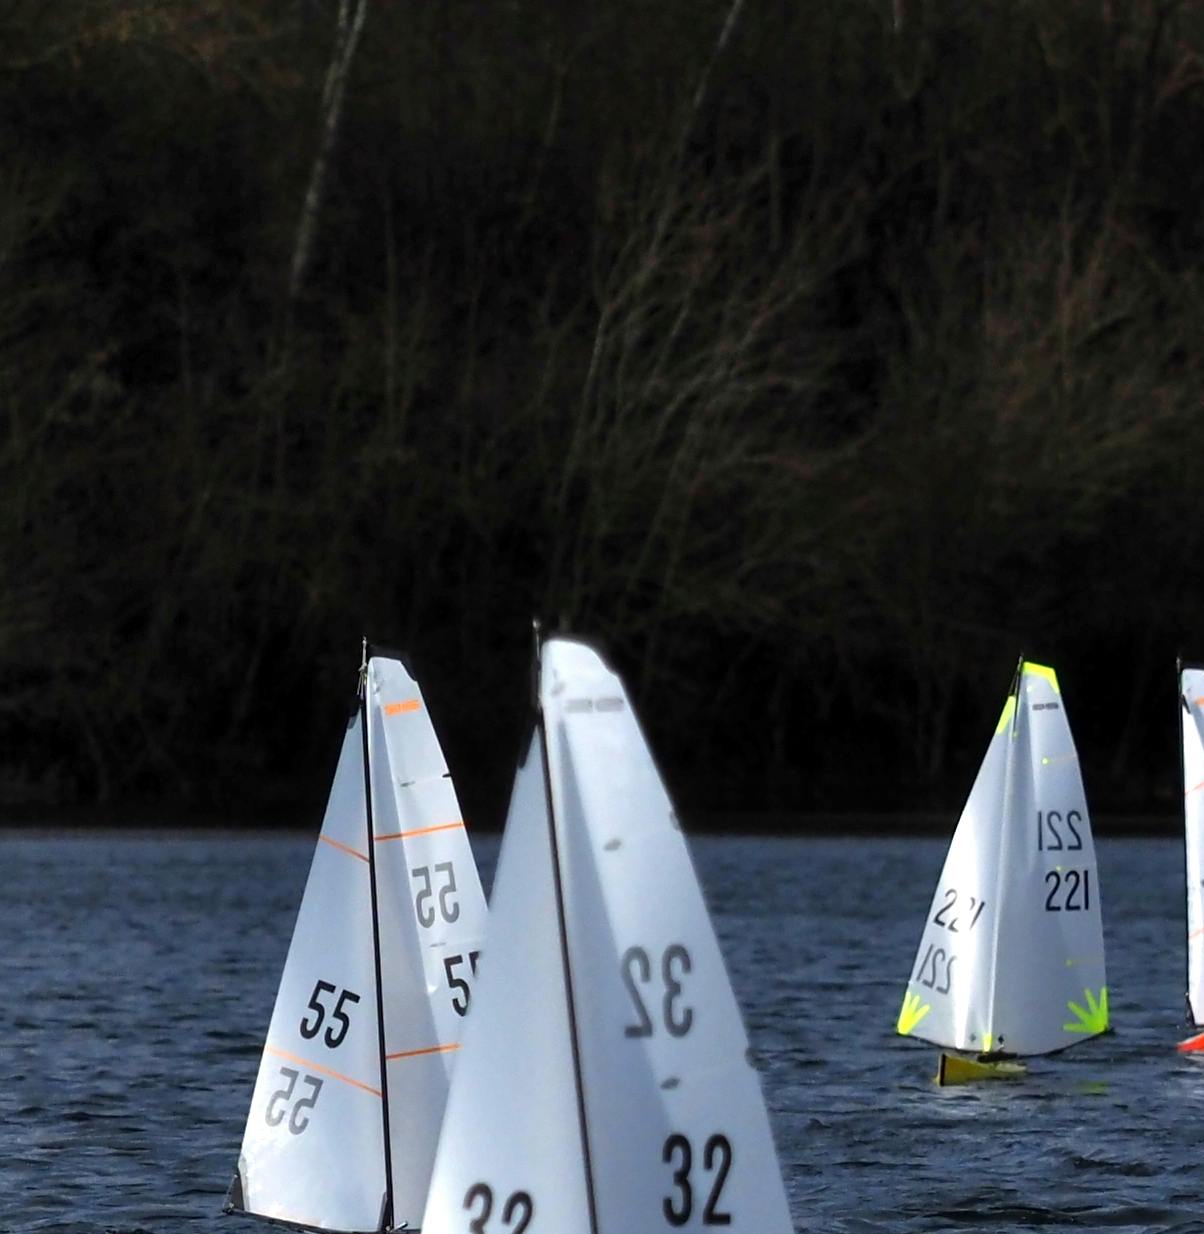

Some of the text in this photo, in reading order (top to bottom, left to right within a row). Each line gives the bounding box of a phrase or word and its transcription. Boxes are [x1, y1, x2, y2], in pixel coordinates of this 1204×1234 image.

[1045, 870, 1089, 912] 221
[299, 980, 361, 1049] 55
[661, 1133, 733, 1227] 32
